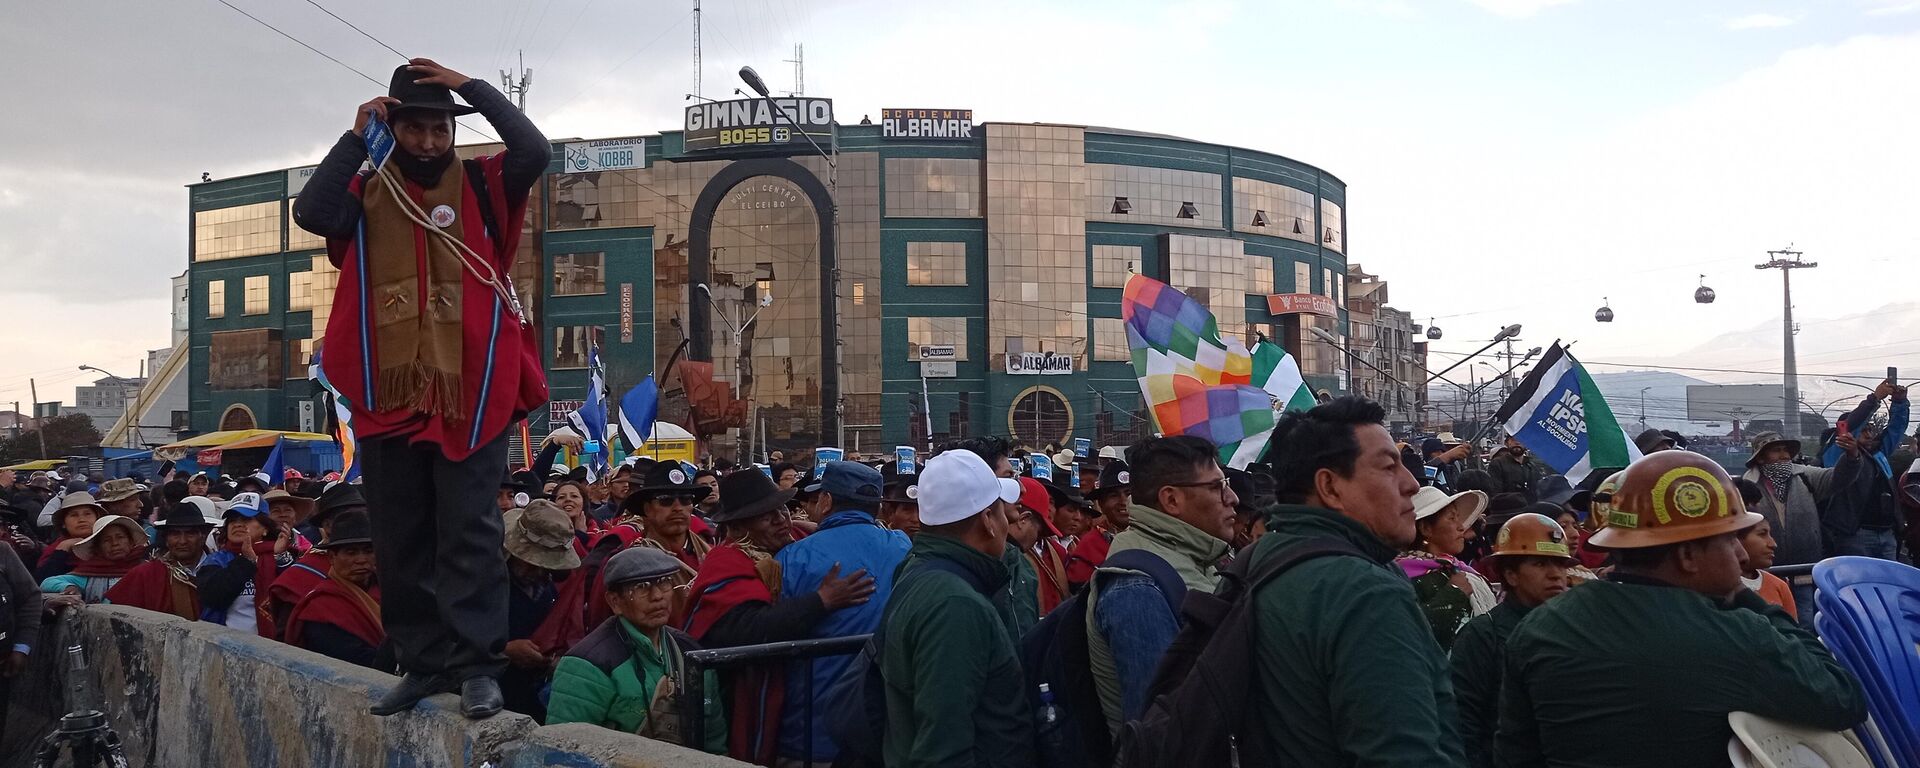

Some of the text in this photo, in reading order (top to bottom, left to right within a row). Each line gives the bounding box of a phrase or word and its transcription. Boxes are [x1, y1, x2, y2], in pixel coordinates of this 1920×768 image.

[687, 100, 830, 131] GIMNASIO
[883, 110, 972, 119] ACADEMIA
[720, 128, 770, 144] BOSS
[883, 119, 972, 137] ALBAMAR
[589, 139, 642, 147] LABORATORIO
[599, 151, 633, 167] KOBBA
[762, 185, 796, 202] CENTRO
[756, 201, 785, 209] CEIBO
[1294, 296, 1311, 305] Banco
[1024, 356, 1071, 370] ALBAMAR
[1560, 388, 1585, 417] MA
[1549, 403, 1587, 435] IPSP
[1537, 420, 1577, 451] AL SOCIALISMO
